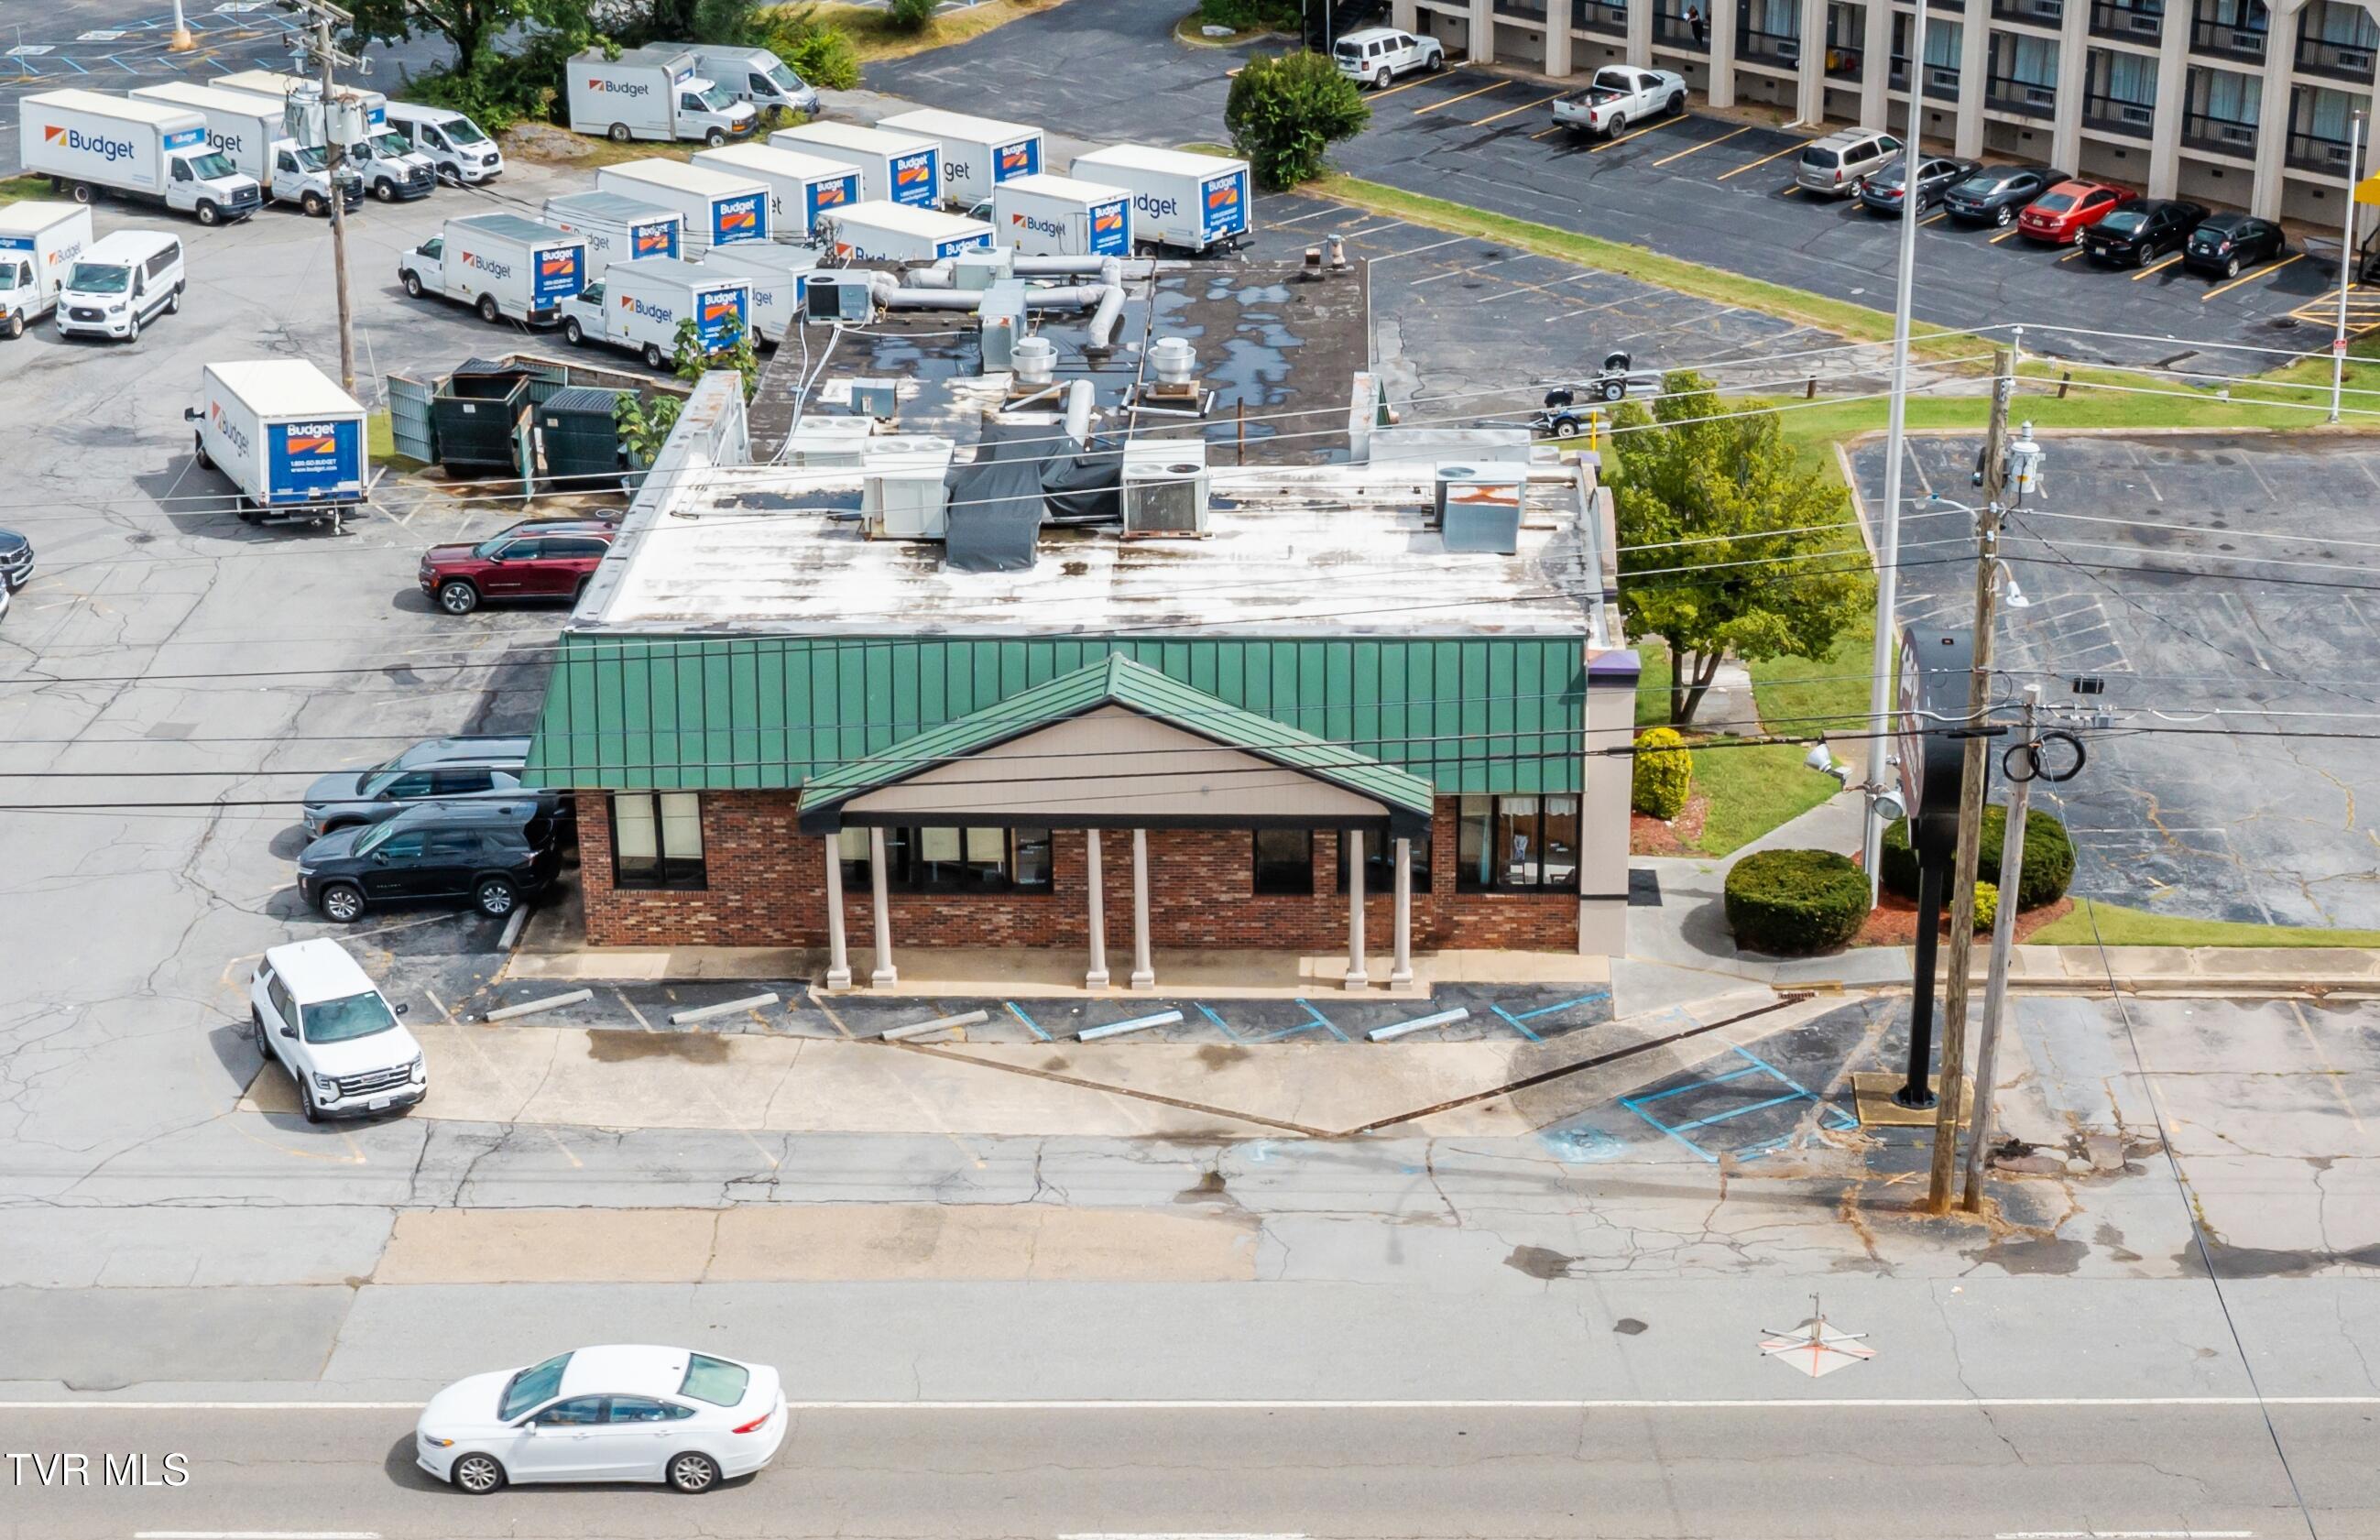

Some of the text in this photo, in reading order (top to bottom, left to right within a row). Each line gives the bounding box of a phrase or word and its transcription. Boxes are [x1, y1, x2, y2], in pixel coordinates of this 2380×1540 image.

[606, 81, 649, 97] Budget
[70, 129, 135, 161] Budget
[207, 129, 242, 154] dget
[1002, 142, 1026, 156] Budget
[898, 154, 928, 170] Budget
[944, 162, 970, 182] get
[1208, 175, 1236, 191] Budget
[720, 199, 756, 215] Budget
[1096, 203, 1123, 217] Budget
[1134, 193, 1177, 219] dget
[542, 248, 573, 261] Budget
[476, 255, 511, 279] Budget
[705, 290, 737, 305] Budget
[636, 299, 672, 323] Budget
[288, 422, 335, 438] Budget
